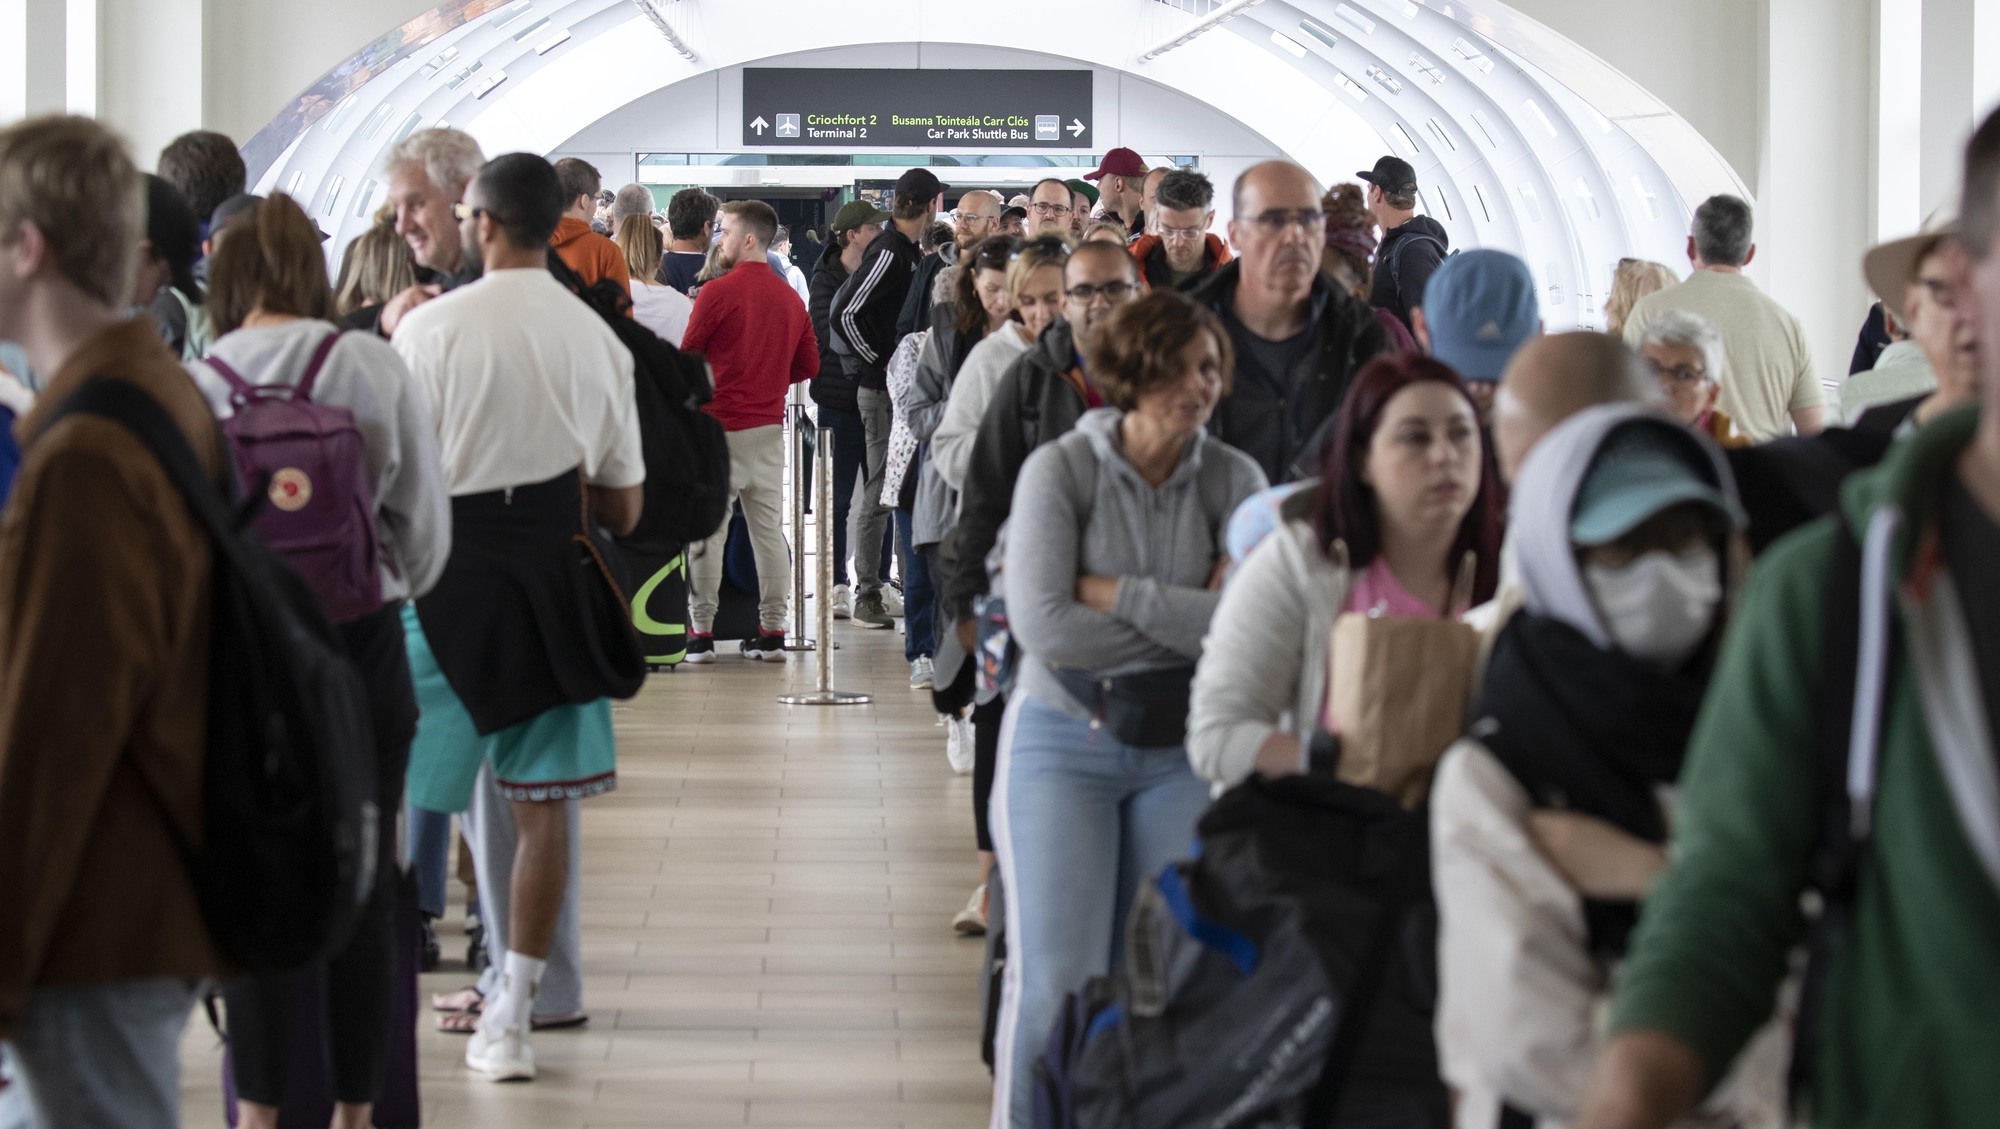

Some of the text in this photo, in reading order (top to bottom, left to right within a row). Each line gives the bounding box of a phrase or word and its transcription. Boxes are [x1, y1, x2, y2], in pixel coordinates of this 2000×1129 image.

[807, 114, 877, 125] Criochfort 2
[892, 115, 1029, 127] Busanna Tointeála Carr Clós
[807, 127, 867, 138] Terminal 2
[927, 128, 1029, 140] Car Park Shuttle Bus
